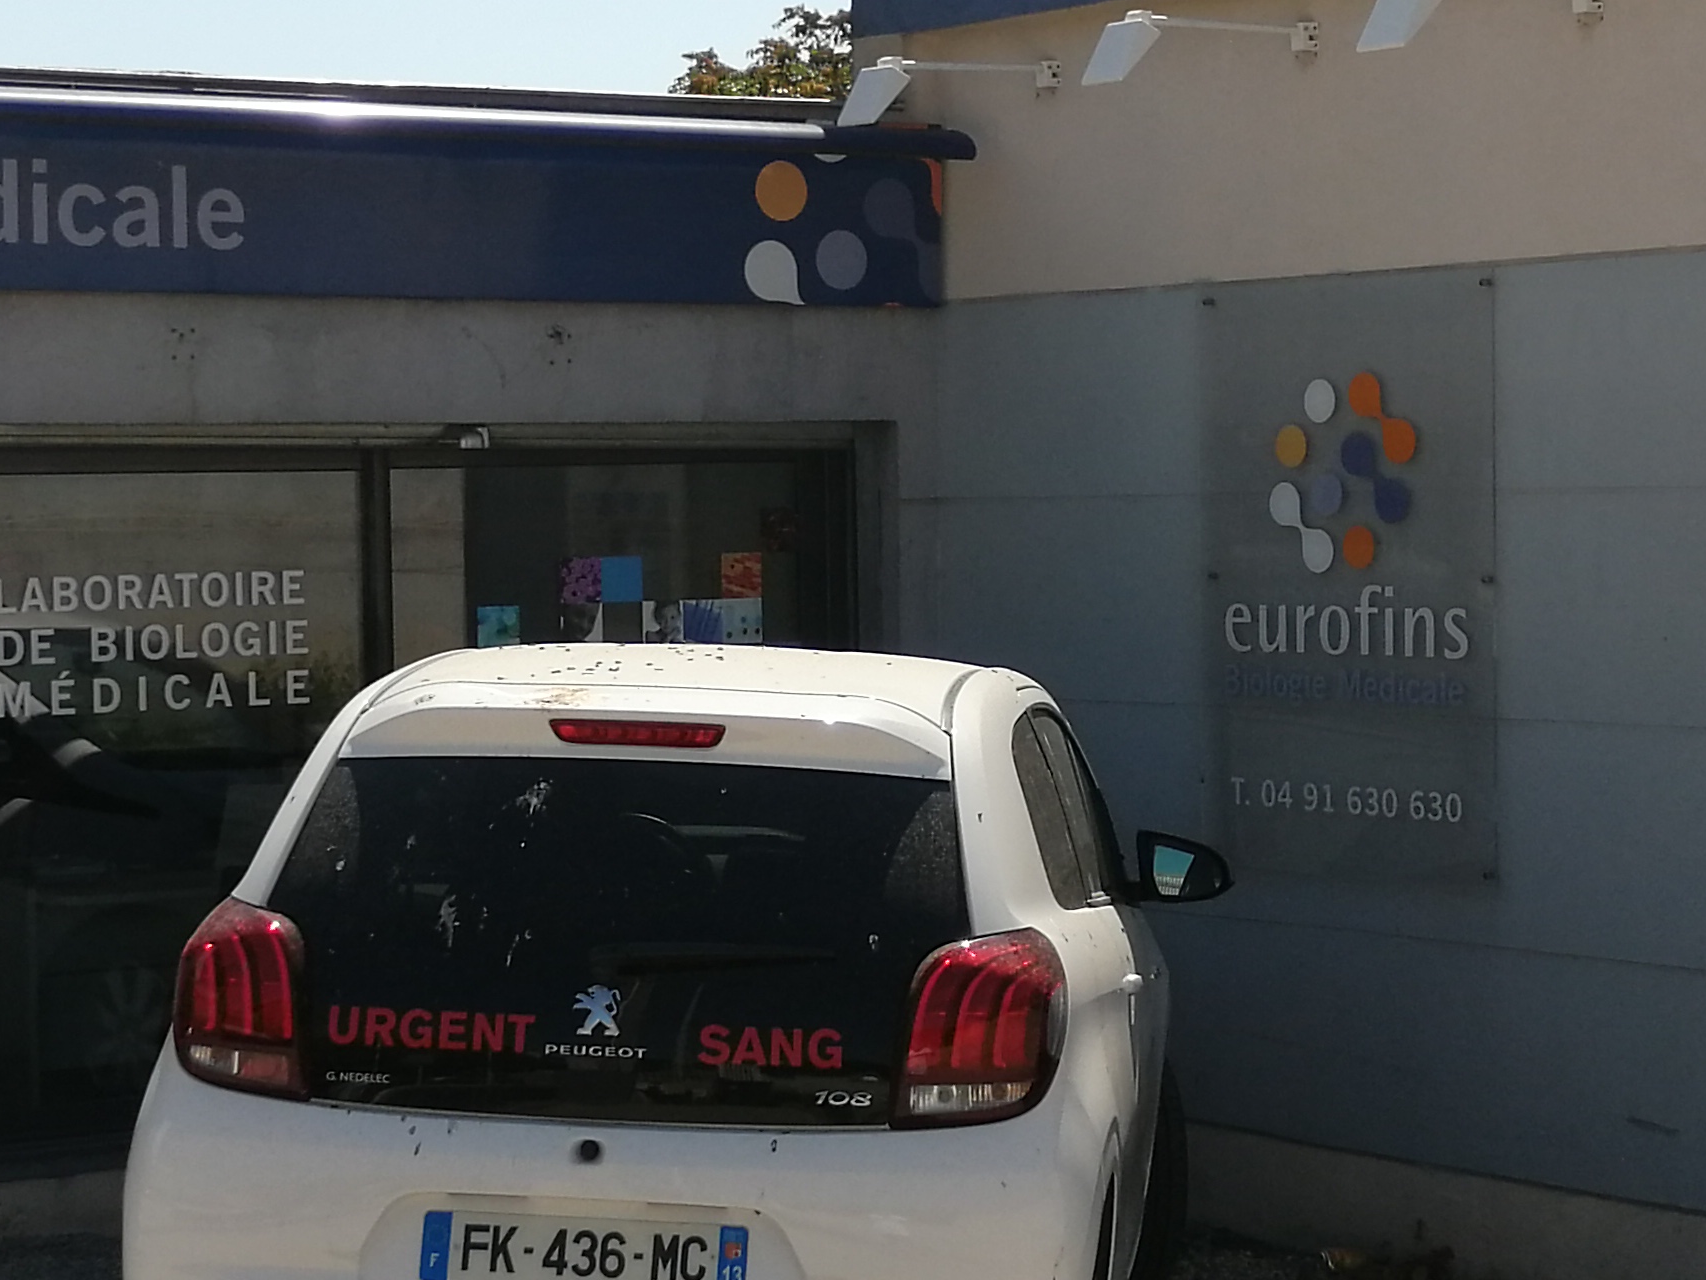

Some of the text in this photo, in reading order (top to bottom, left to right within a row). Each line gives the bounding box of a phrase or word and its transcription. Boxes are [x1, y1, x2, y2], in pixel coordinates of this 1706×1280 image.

[90, 618, 310, 664] BIOLOGIE
[1224, 584, 1470, 660] eurofins
[1223, 663, 1326, 707] Biologie
[1230, 776, 1463, 823] T. 04 91 630 630
[326, 1005, 844, 1070] URGENT SANG
[544, 1042, 648, 1060] PEUGEOT
[339, 1072, 391, 1084] NEDELEC
[814, 1089, 873, 1108] 108
[430, 1252, 440, 1268] F
